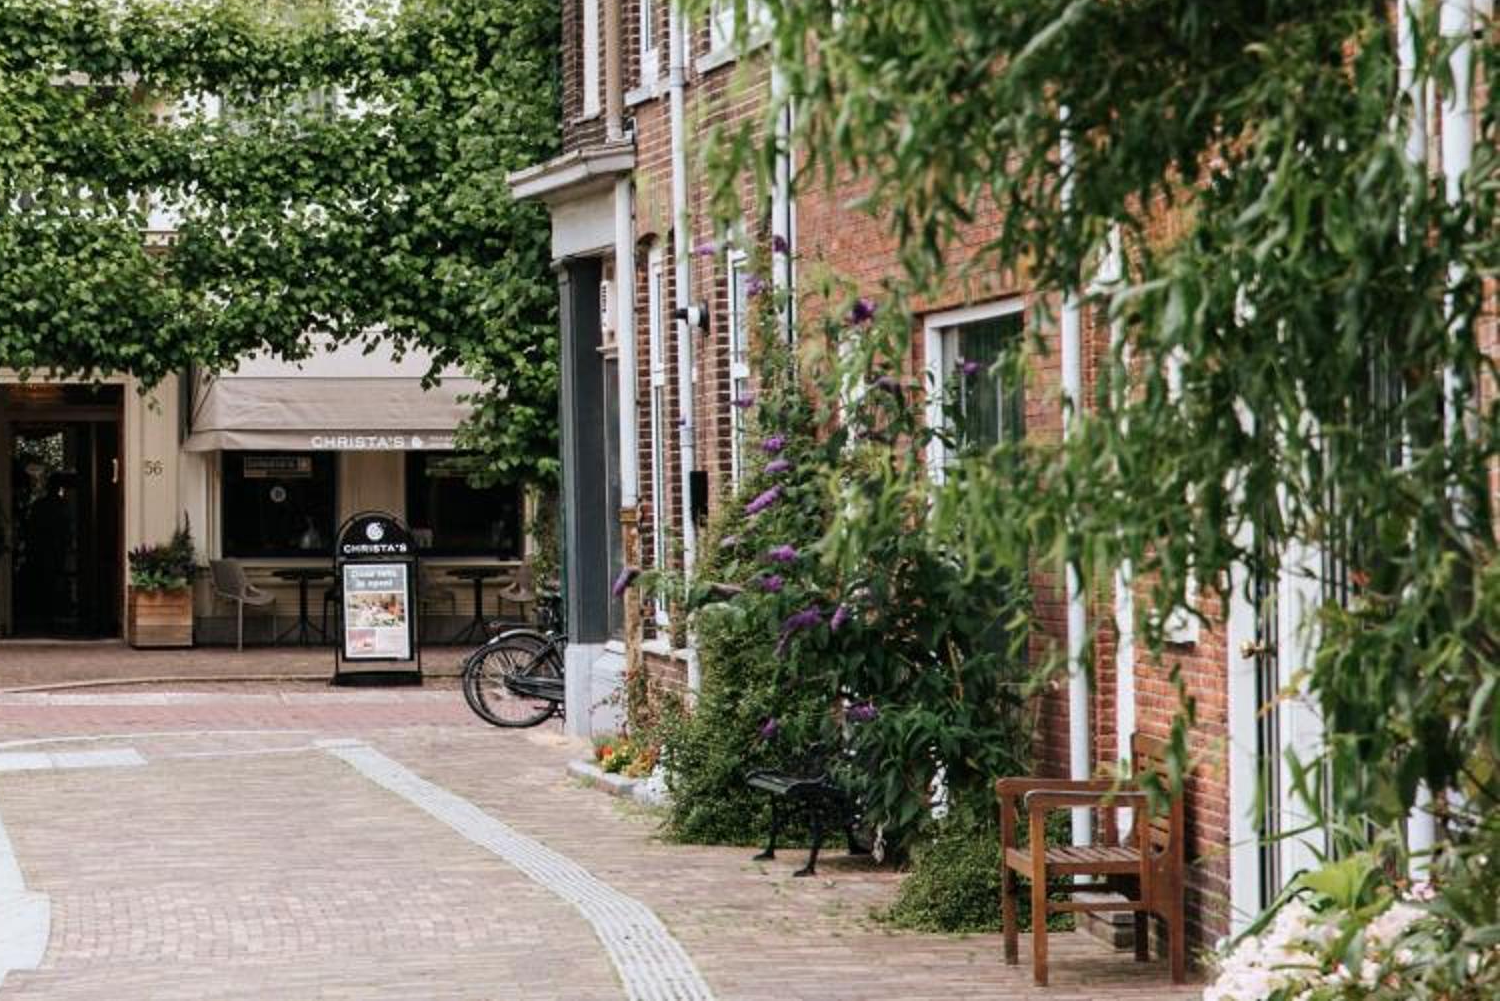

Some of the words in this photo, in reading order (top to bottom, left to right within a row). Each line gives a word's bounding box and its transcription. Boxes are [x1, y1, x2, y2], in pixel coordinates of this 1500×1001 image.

[310, 435, 405, 449] CHRISTA'S
[144, 459, 163, 476] 56
[343, 543, 407, 554] CHRISTA'S
